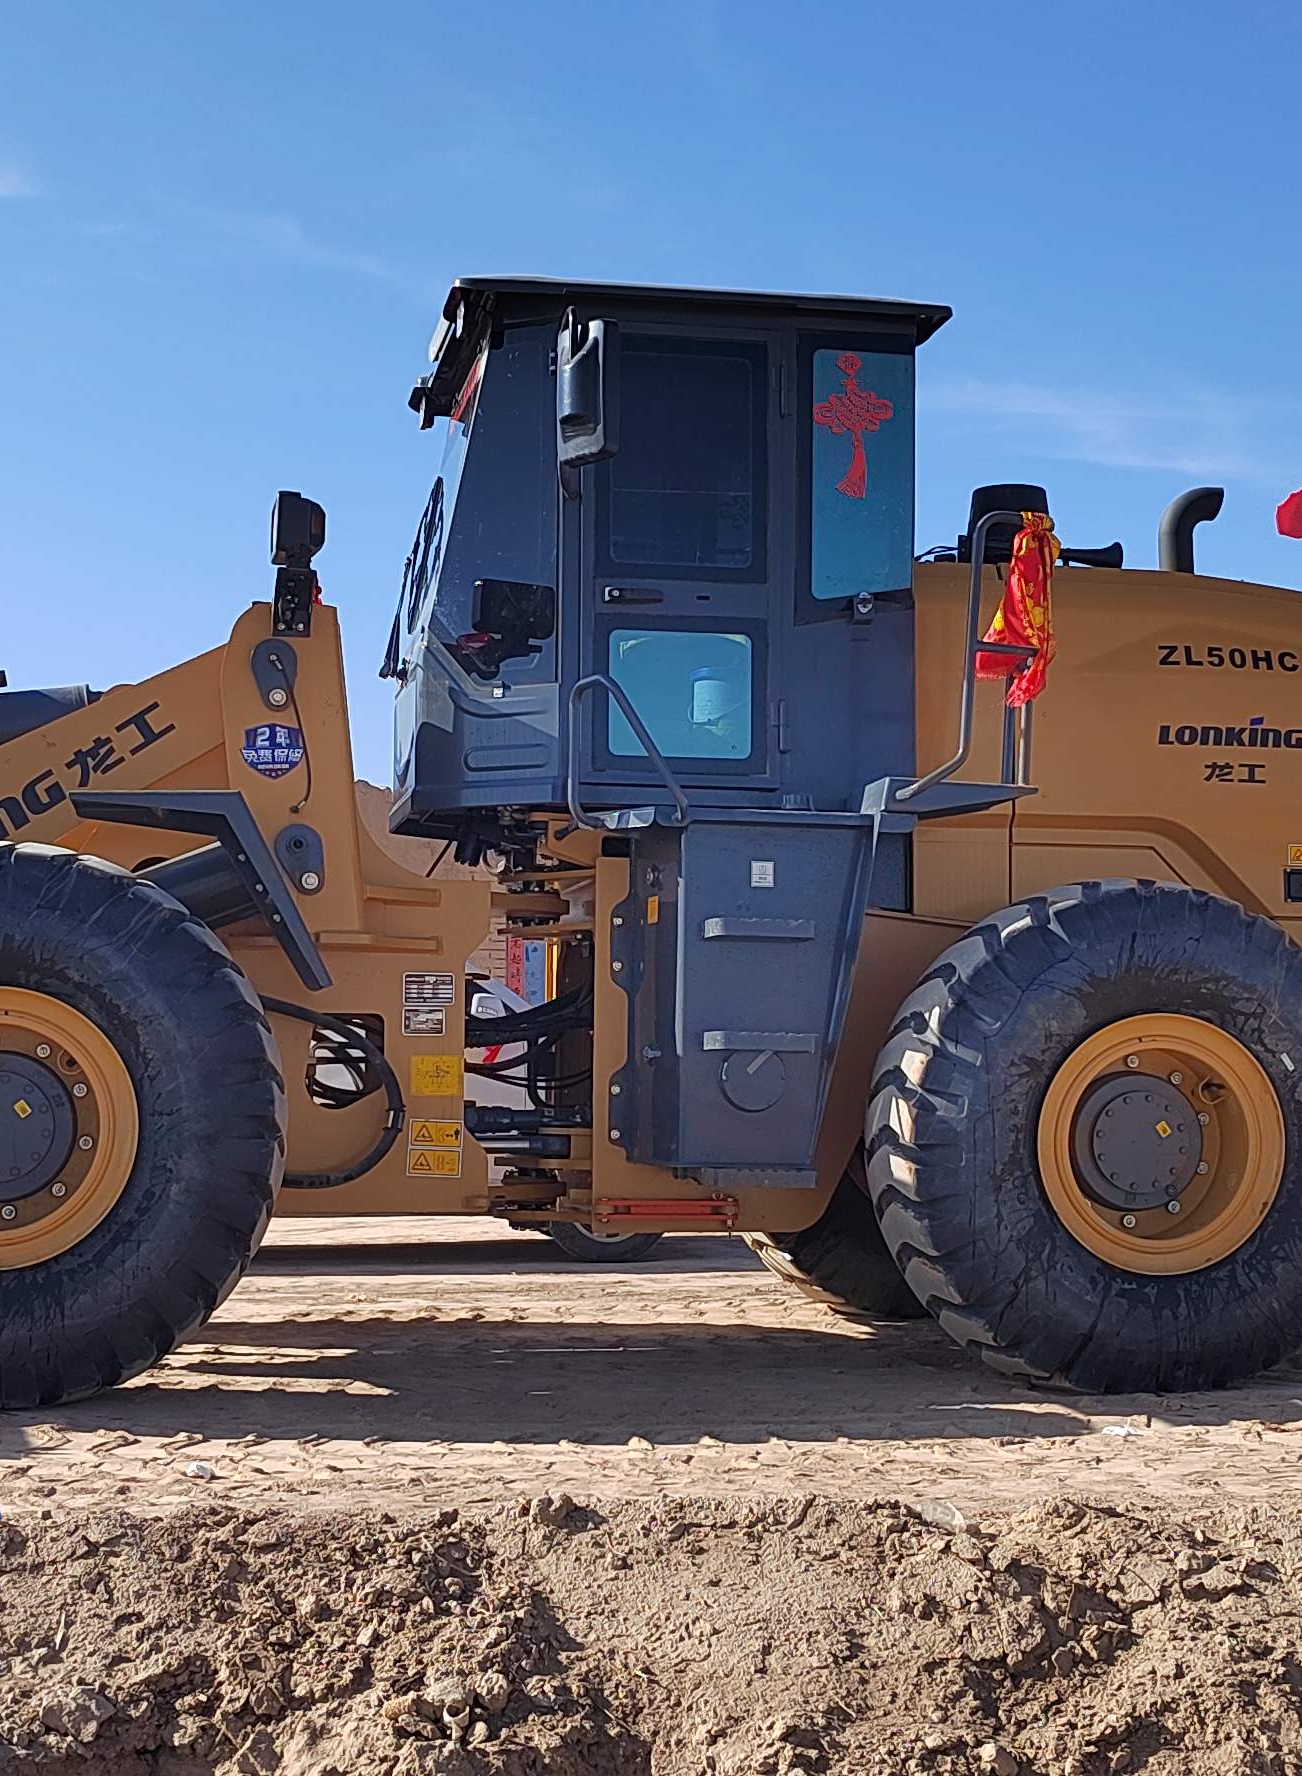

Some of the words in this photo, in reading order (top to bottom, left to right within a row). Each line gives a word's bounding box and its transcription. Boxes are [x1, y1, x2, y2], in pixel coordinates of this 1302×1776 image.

[1157, 645, 1300, 673] ZL50HC
[65, 701, 176, 788] 龙工
[1203, 761, 1267, 785] 龙工
